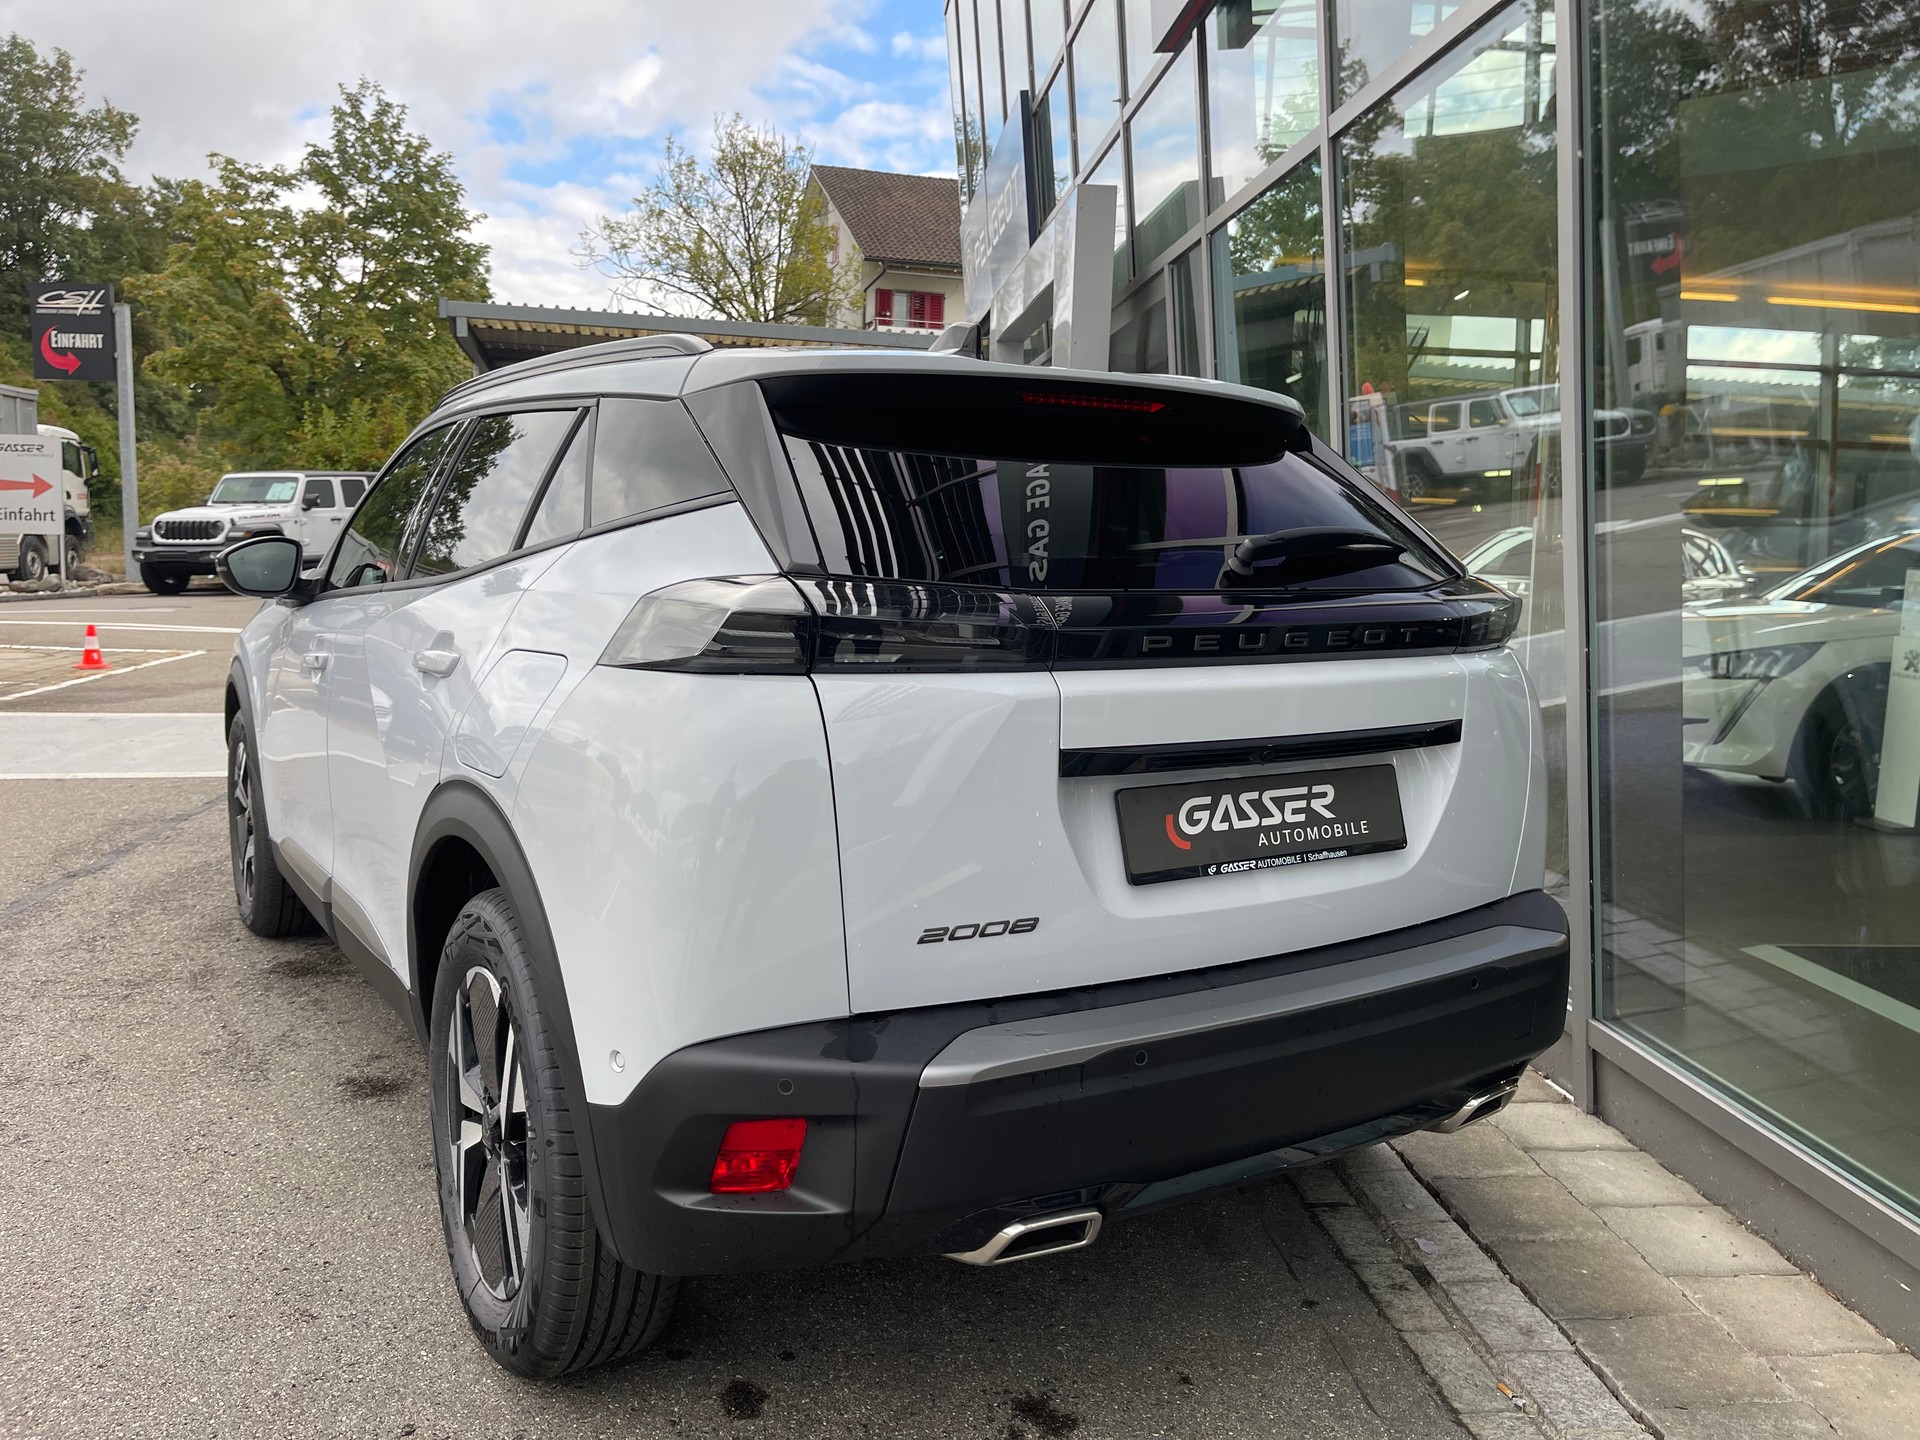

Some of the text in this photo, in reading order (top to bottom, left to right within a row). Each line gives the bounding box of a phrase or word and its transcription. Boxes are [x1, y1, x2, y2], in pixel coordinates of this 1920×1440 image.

[974, 162, 1020, 277] PEUGEOT
[50, 330, 105, 349] EINFAHRT
[1142, 627, 1420, 652] PEUGEOT
[1178, 784, 1337, 836] GASSER
[1258, 820, 1370, 848] AUTOMOBILE
[1220, 861, 1256, 874] GASSER
[1257, 854, 1302, 869] AUTOMOBILE
[1307, 849, 1348, 862] Schaffhausen
[916, 916, 1040, 945] 2008
